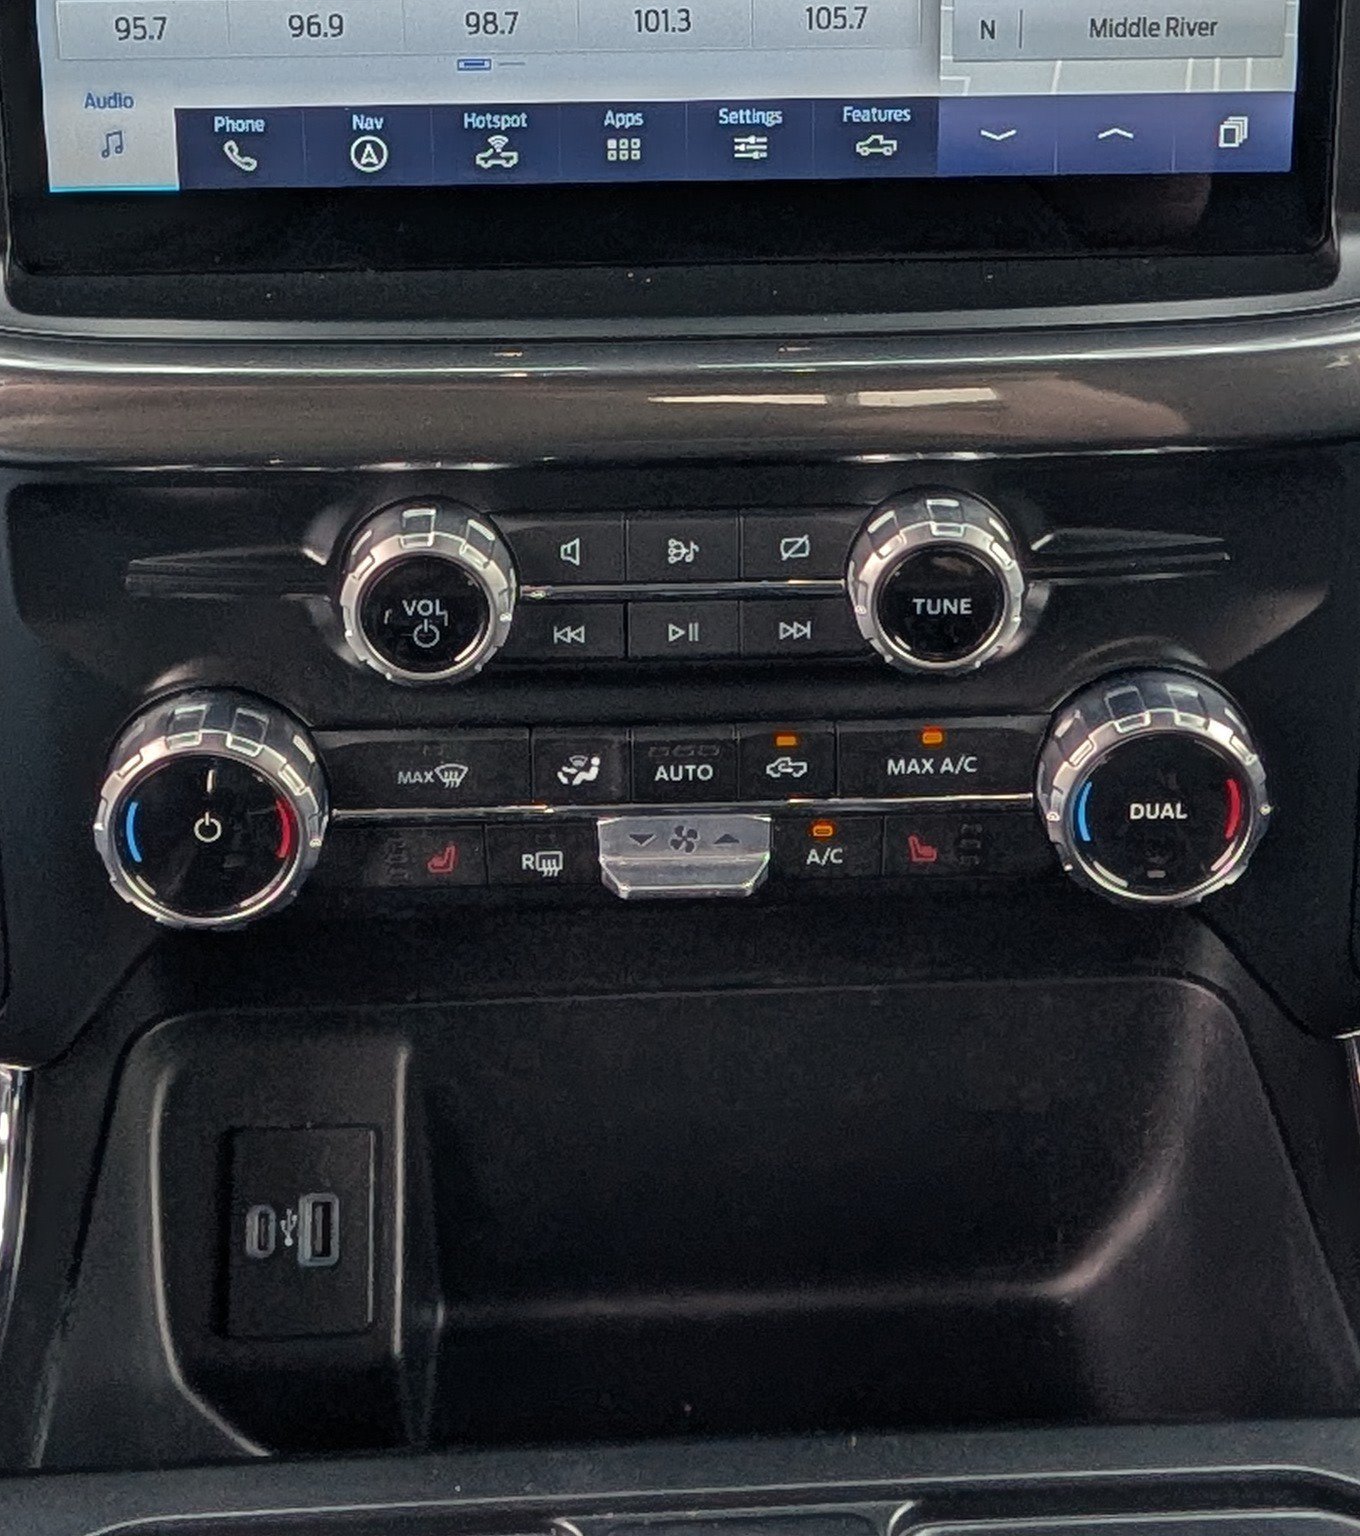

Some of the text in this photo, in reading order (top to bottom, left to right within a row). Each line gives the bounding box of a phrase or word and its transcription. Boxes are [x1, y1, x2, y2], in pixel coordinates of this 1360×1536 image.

[114, 16, 167, 41] 95.7
[287, 14, 344, 39] 96.9
[464, 11, 520, 36] 98.7
[632, 8, 692, 33] 101.3
[805, 6, 868, 31] 105.7
[1089, 17, 1218, 38] Middle River
[981, 20, 996, 40] N
[84, 92, 135, 110] Audio
[214, 115, 265, 133] Phone
[352, 113, 383, 131] Nav
[463, 111, 528, 132] Hotspot
[604, 110, 644, 130] Apps
[718, 107, 783, 128] Settings
[843, 105, 911, 123] Features
[402, 598, 448, 617] VOL
[912, 597, 972, 616] TUNE
[655, 765, 713, 782] AUTO
[887, 754, 978, 776] MAX A/C
[397, 770, 434, 785] MAX
[1129, 803, 1187, 820] DUAL
[806, 848, 843, 867] A/C
